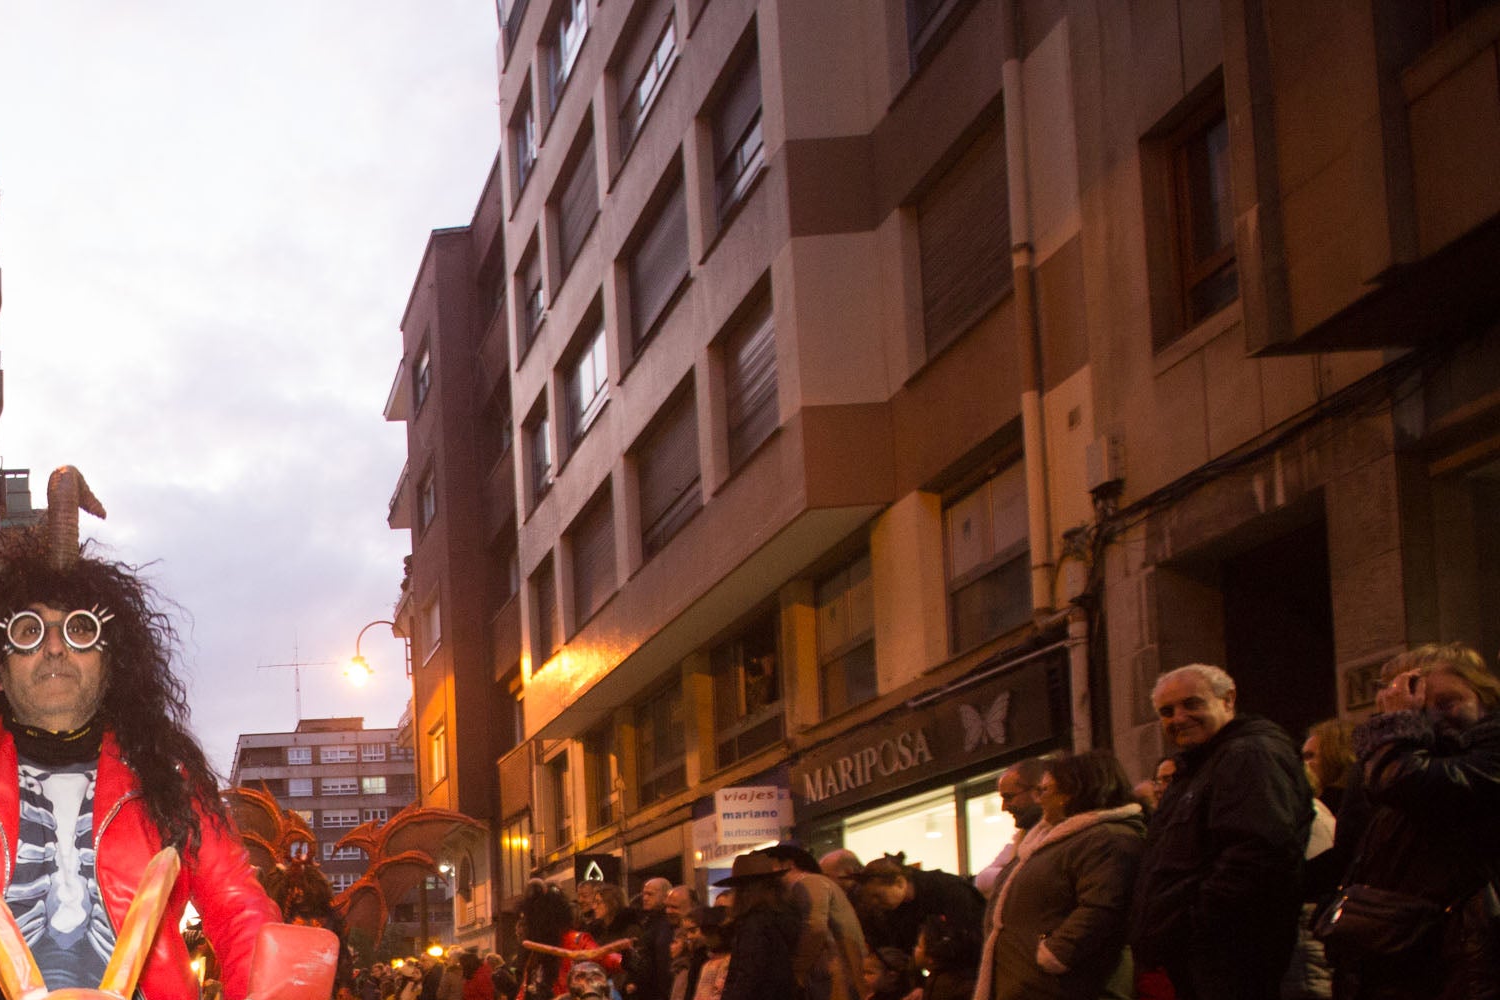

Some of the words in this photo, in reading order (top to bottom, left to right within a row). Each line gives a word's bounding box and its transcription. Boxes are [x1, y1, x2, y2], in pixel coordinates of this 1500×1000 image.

[803, 727, 934, 806] MARIPOSA
[723, 790, 775, 803] viajes
[722, 809, 778, 821] mariano
[723, 827, 779, 838] autocares
